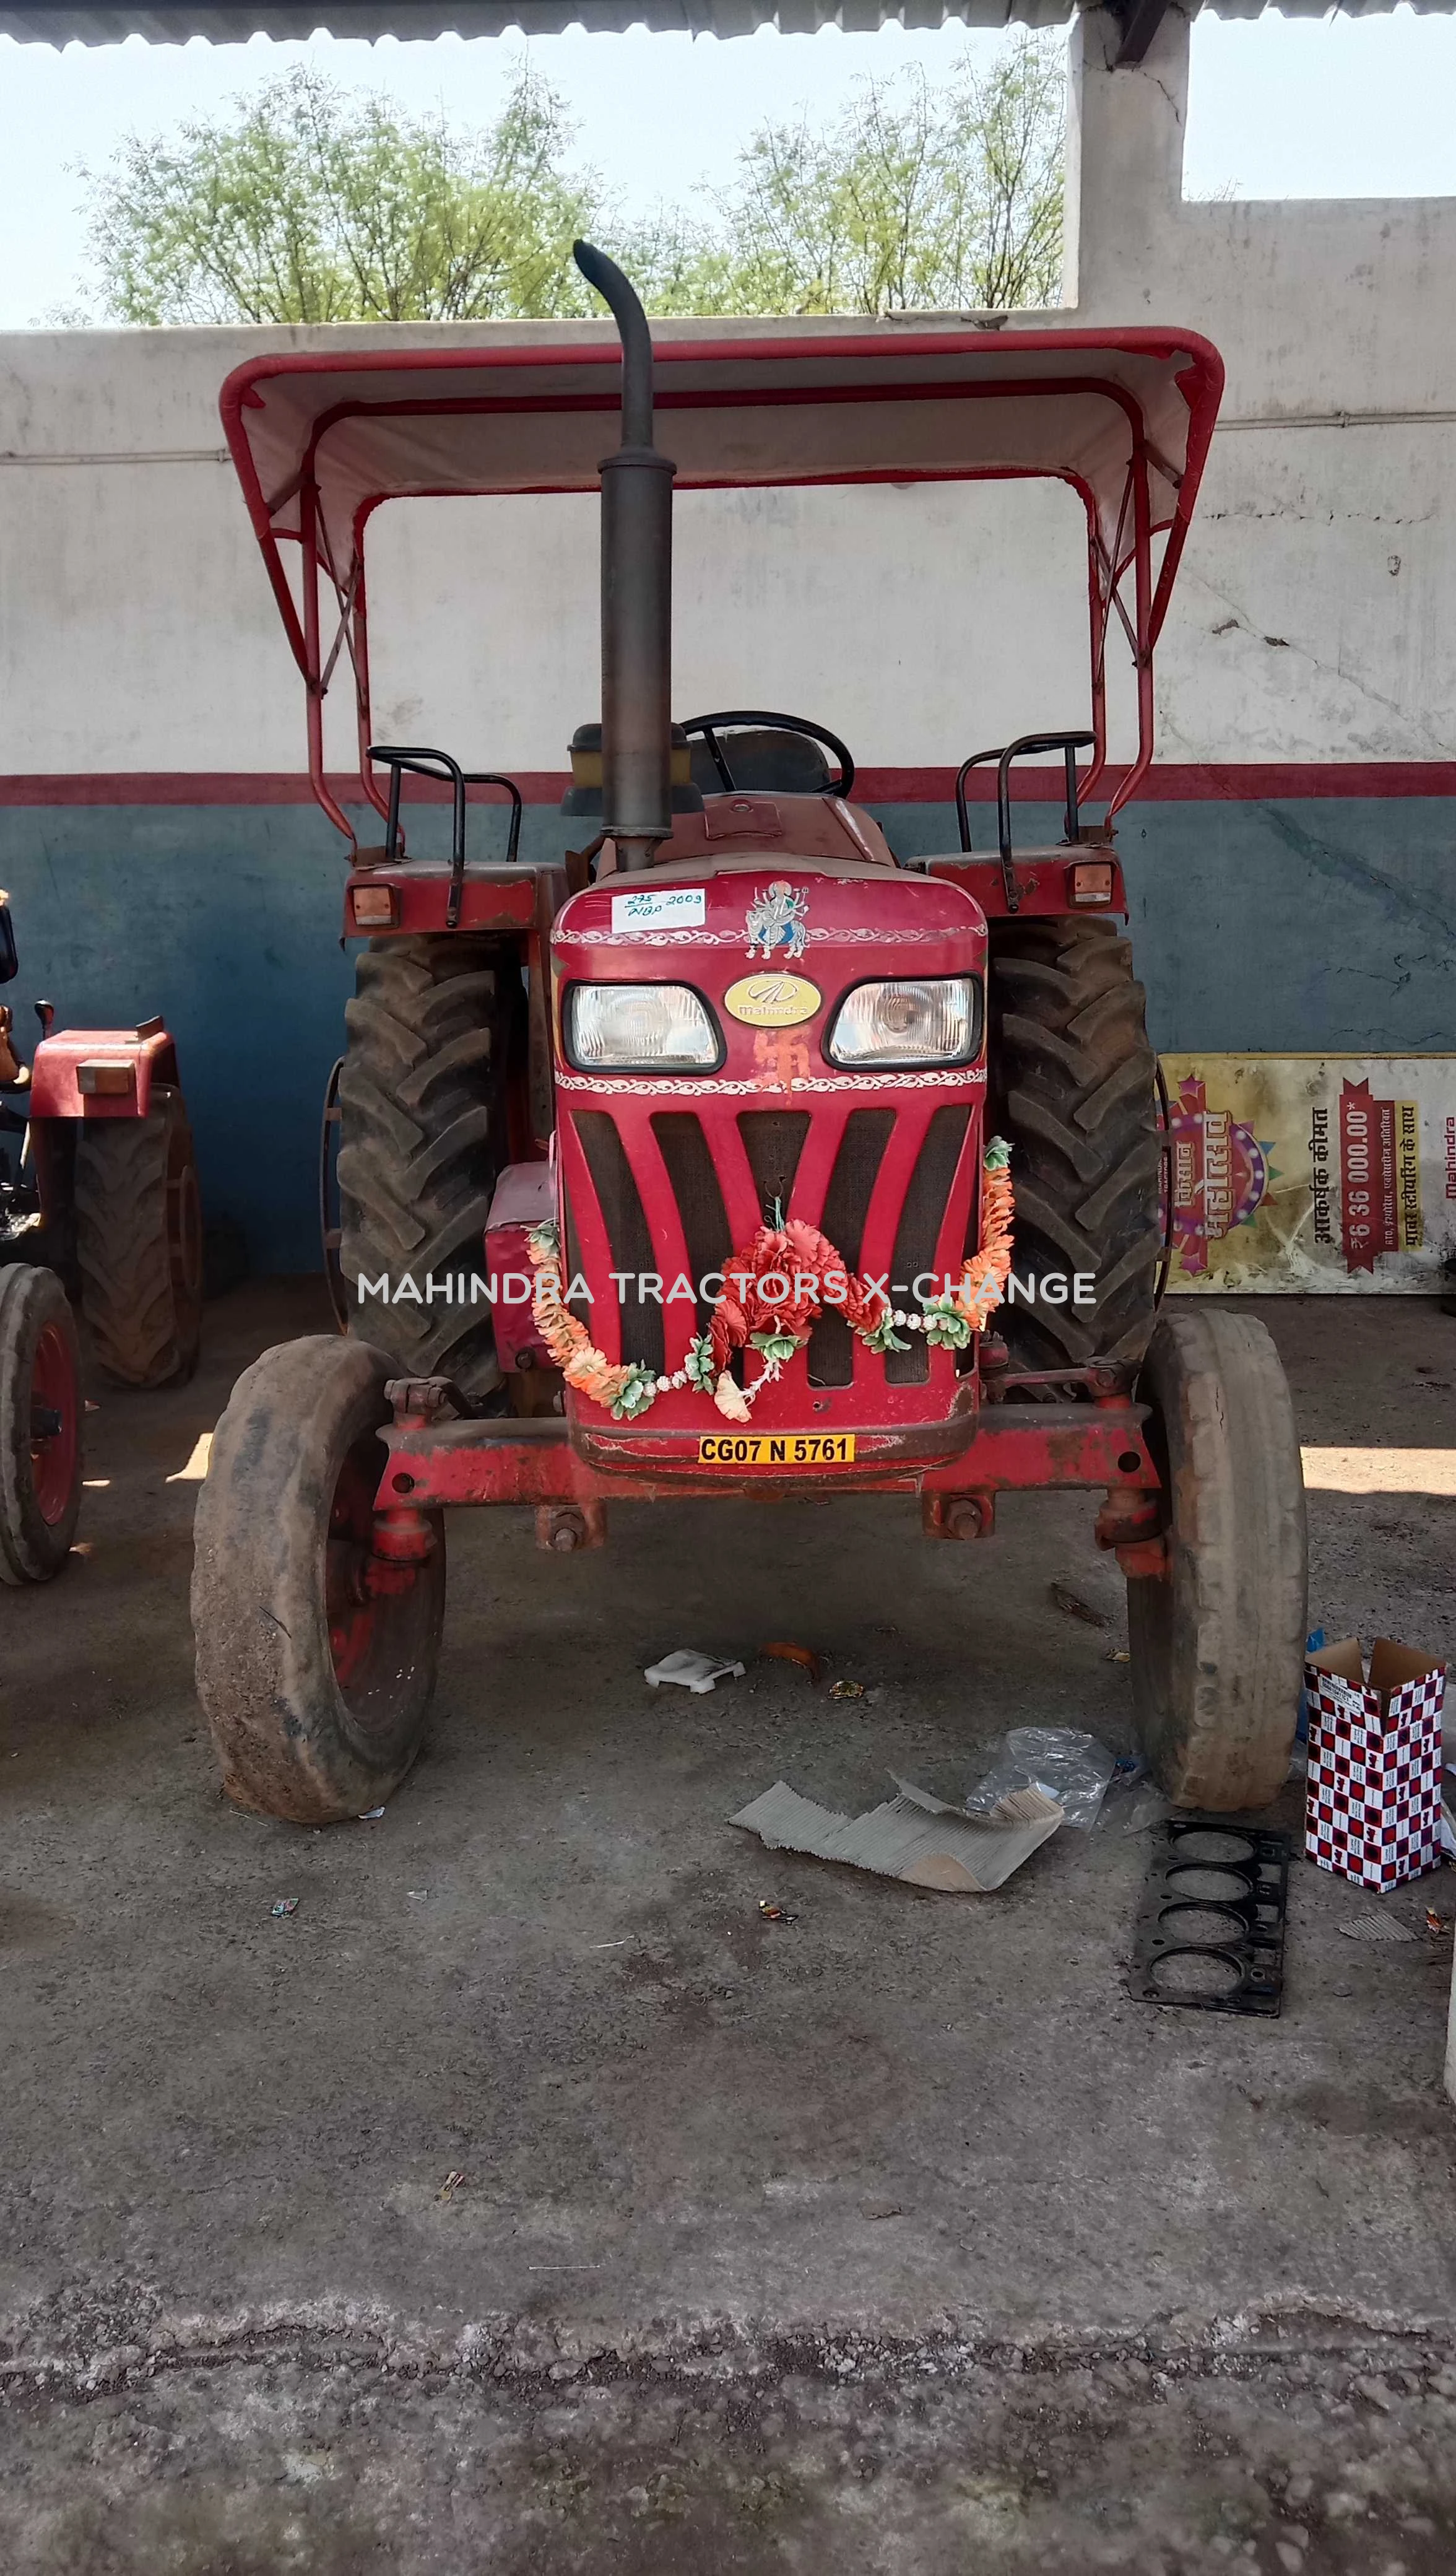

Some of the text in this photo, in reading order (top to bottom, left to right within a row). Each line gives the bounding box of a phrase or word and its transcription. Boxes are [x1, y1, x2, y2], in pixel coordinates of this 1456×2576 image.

[1174, 1141, 1193, 1208] किसान
[1195, 1111, 1232, 1238] महोत्सव
[1309, 1107, 1330, 1243] आकर्षक कीमत
[1400, 1106, 1418, 1245] पावर स्टीयरिंग के साथ
[1444, 1117, 1456, 1199] Mahindra
[1348, 1191, 1370, 1216] 36
[701, 1438, 847, 1461] CG07 N 5761
